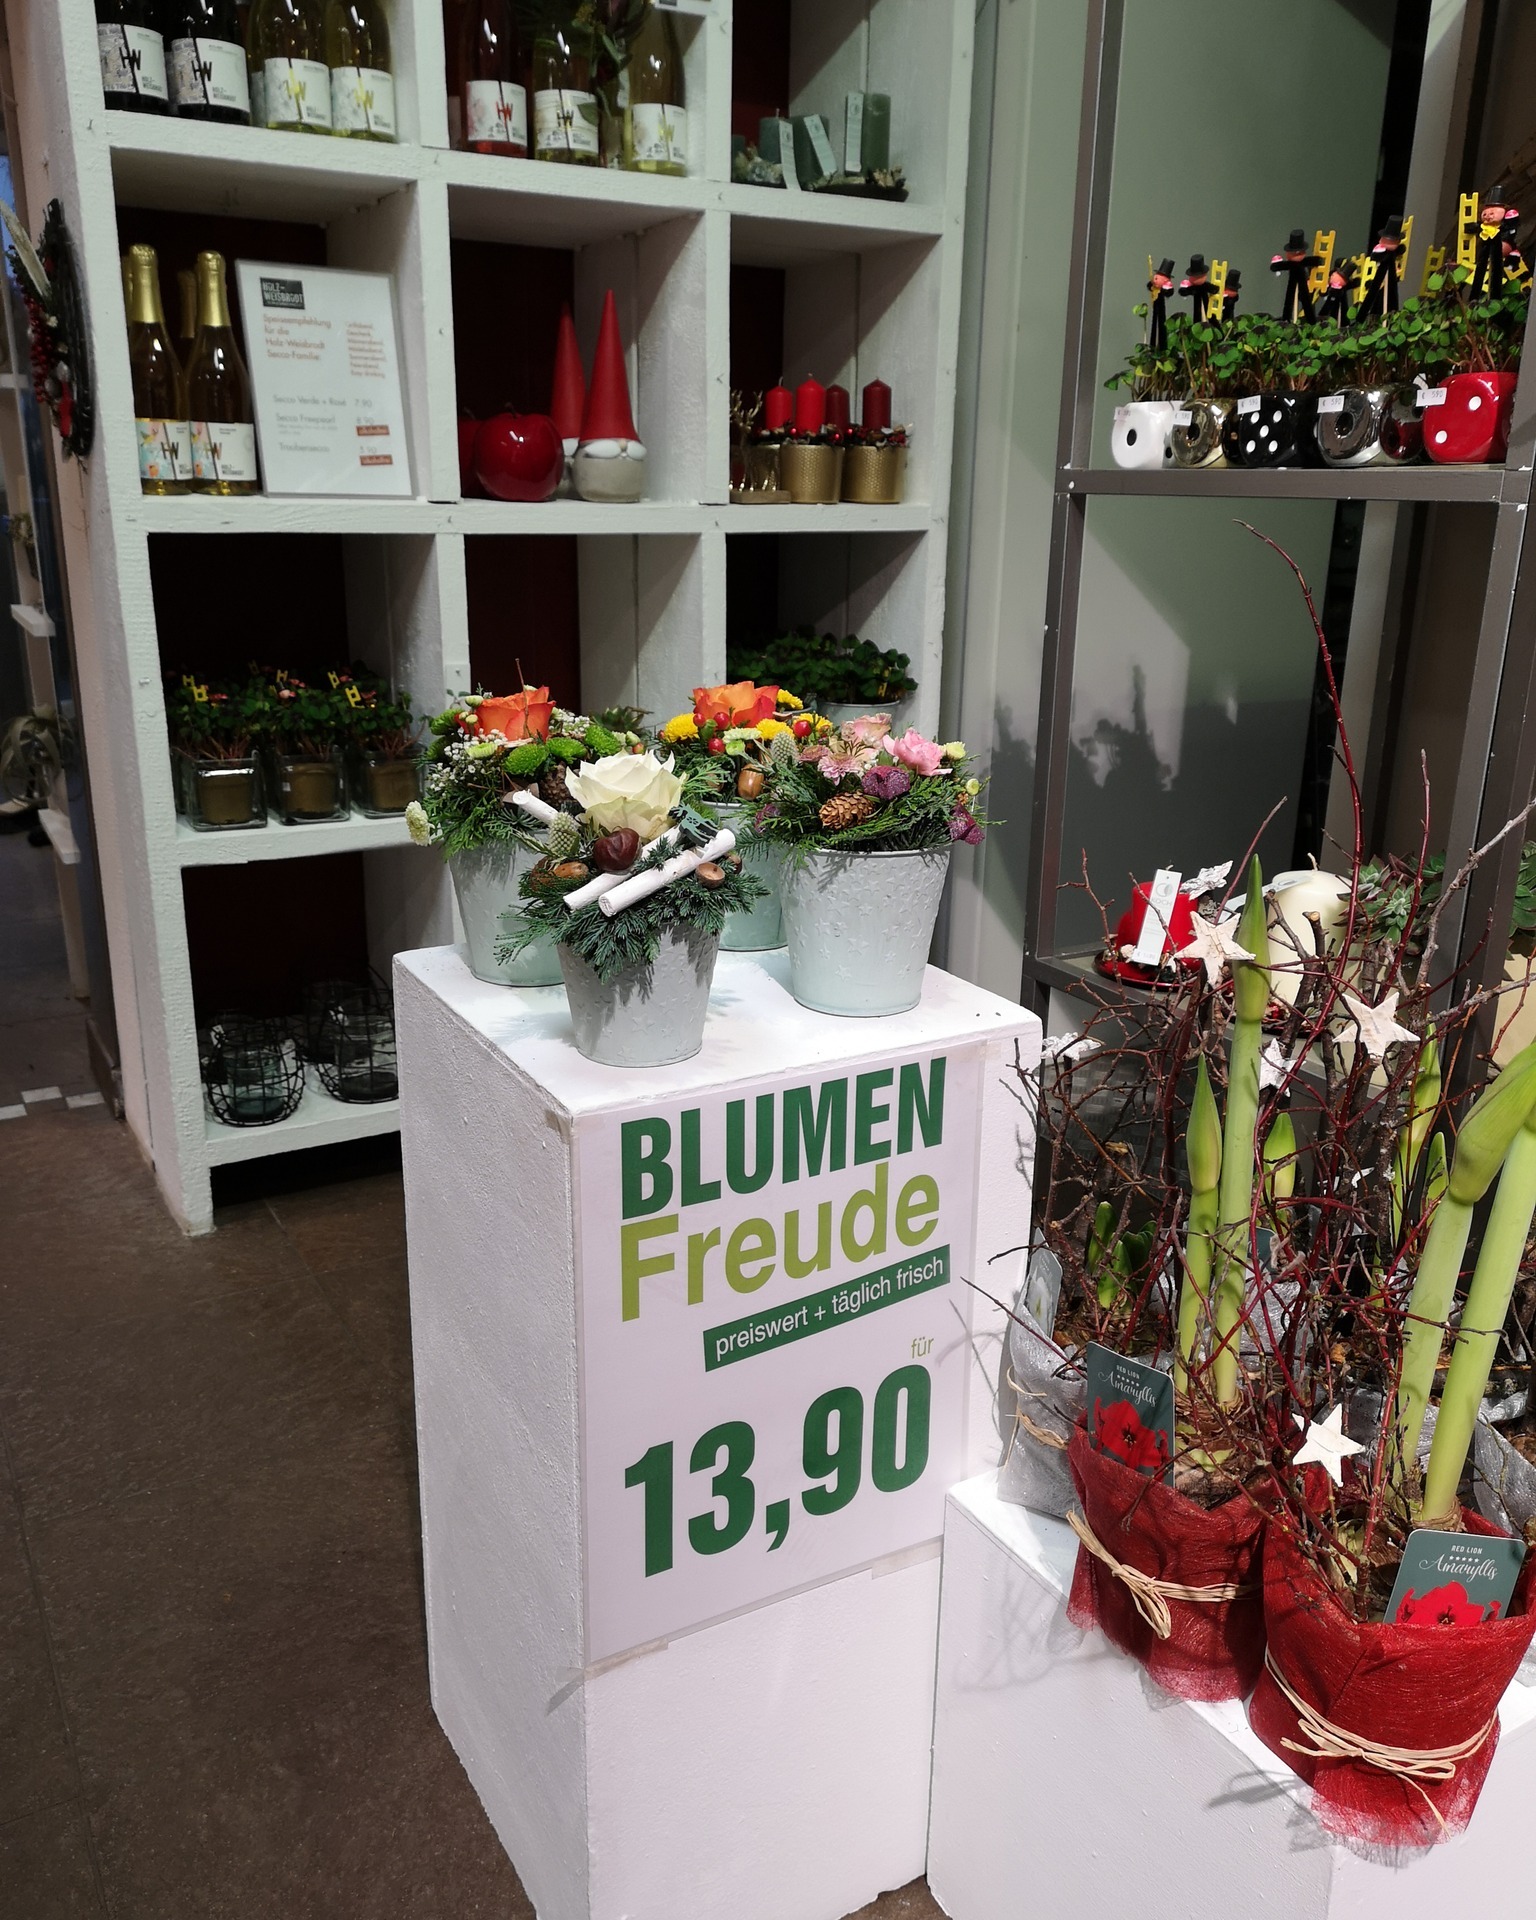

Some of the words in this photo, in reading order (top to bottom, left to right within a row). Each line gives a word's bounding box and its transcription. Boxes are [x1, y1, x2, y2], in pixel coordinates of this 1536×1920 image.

[621, 1056, 947, 1219] BLUMEN
[621, 1163, 940, 1322] Freude
[716, 1306, 808, 1362] preiswert
[814, 1306, 826, 1321] +
[832, 1276, 890, 1314] täglich
[897, 1257, 943, 1290] frisch
[911, 1336, 934, 1359] für
[1098, 1371, 1157, 1407] Amaryllis
[1116, 1365, 1126, 1374] RED
[1128, 1369, 1140, 1379] LION
[624, 1364, 932, 1578] 13,90
[1451, 1545, 1464, 1553] RED
[1467, 1545, 1482, 1554] LION
[1419, 1554, 1498, 1582] Amaryllis
